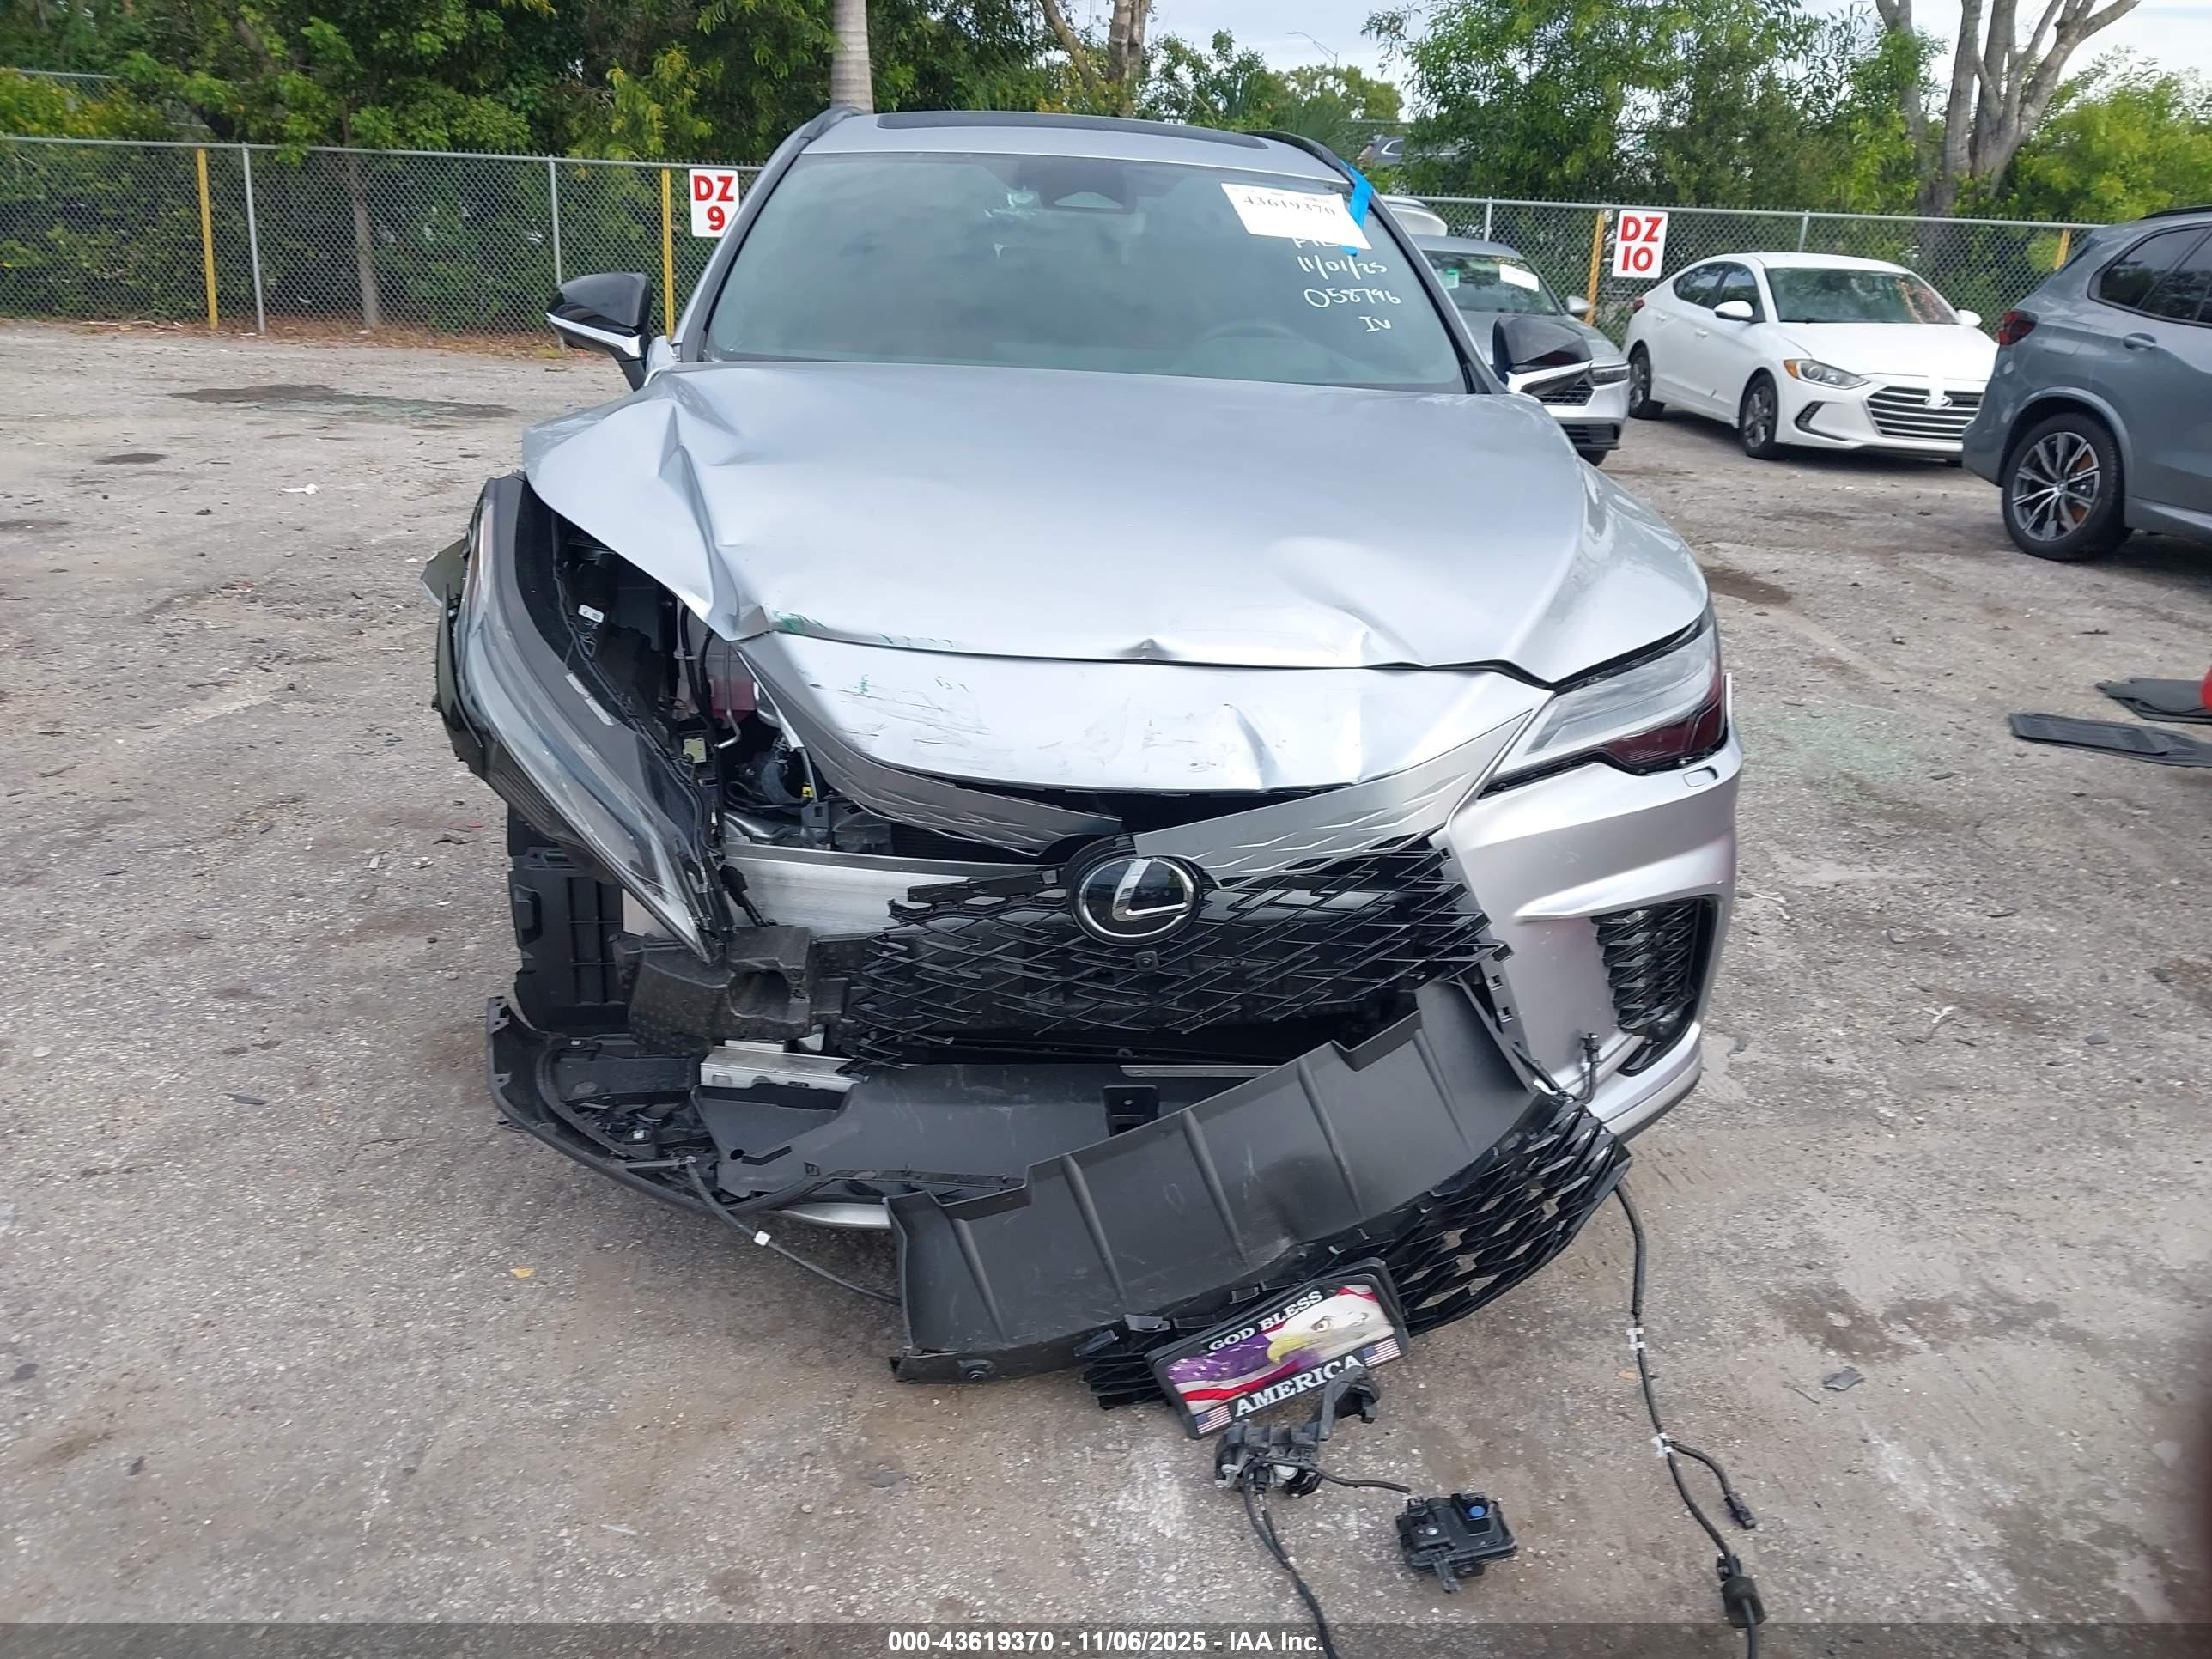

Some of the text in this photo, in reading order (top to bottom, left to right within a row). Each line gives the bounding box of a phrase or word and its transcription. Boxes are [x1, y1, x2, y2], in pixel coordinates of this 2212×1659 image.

[693, 174, 735, 202] DZ
[707, 205, 726, 231] 9
[1620, 216, 1664, 242] DZ
[1297, 254, 1388, 281] 11/01/25
[1621, 246, 1654, 272] 10
[1304, 288, 1402, 308] 058796
[1208, 1290, 1324, 1352] GOD BLESS
[1234, 1354, 1364, 1417] AMERICA
